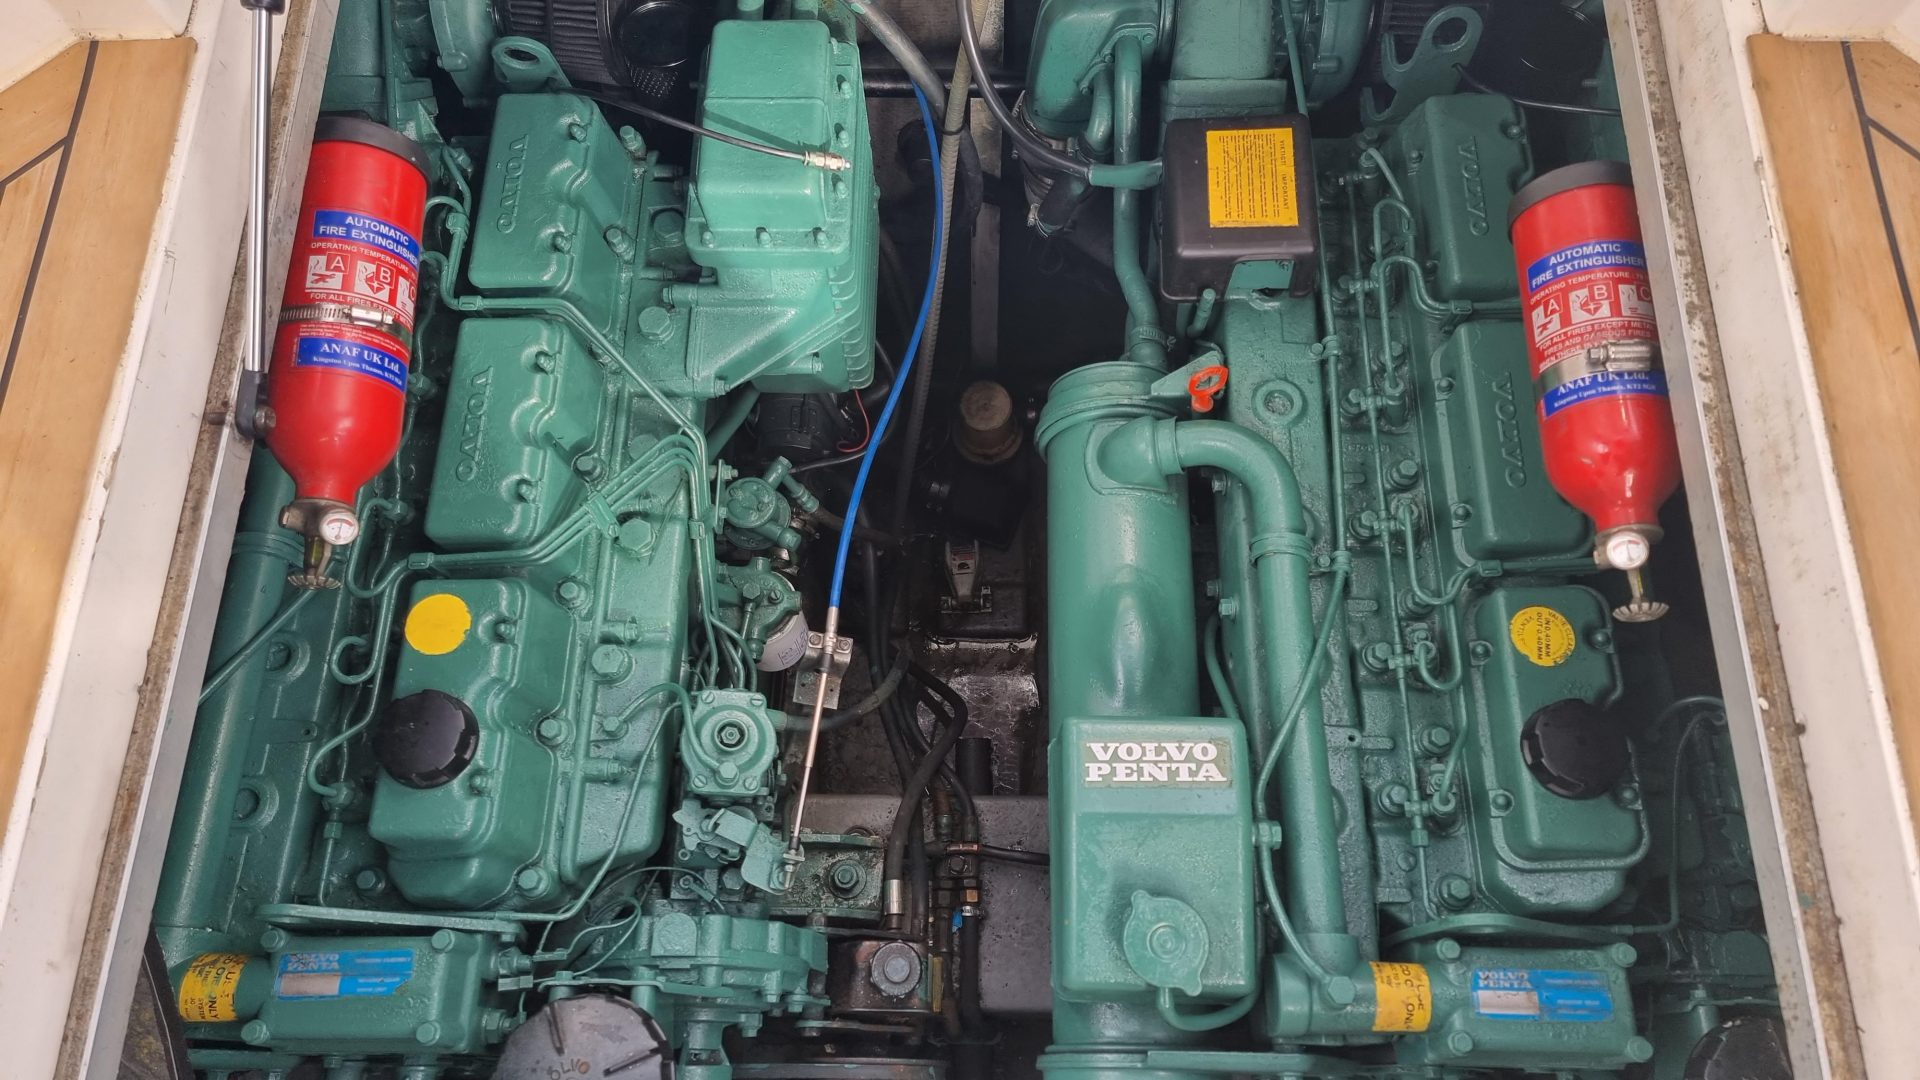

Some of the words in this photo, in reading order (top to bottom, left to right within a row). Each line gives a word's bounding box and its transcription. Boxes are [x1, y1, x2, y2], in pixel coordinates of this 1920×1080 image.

[497, 134, 529, 234] VOLVO
[1281, 173, 1289, 210] IMPORTANT
[1458, 135, 1490, 236] VOLVO
[345, 215, 409, 245] AUTOMATIC
[311, 242, 357, 252] OPERATING
[359, 247, 409, 272] TEMPERATURE
[319, 225, 347, 237] FIRE
[351, 229, 418, 266] EXTINGUISHER
[1549, 243, 1622, 266] AUTOMATIC
[330, 256, 345, 271] A
[379, 267, 391, 283] B
[1532, 270, 1554, 289] FIRE
[1556, 255, 1645, 275] EXTINGUISHER
[310, 292, 326, 300] FOR
[328, 294, 345, 302] ALL
[347, 296, 371, 307] FIRES
[1530, 282, 1566, 305] OPERATING
[1568, 271, 1630, 286] TEMPERATURE
[1593, 284, 1608, 300] B
[1640, 286, 1651, 300] C
[1546, 298, 1560, 316] A
[1552, 333, 1567, 344] ALL
[1567, 326, 1593, 339] FIRES
[1594, 320, 1628, 330] EXCEPT
[1565, 337, 1582, 349] AND
[1629, 329, 1651, 338] FIRES
[320, 342, 361, 357] ANAF
[363, 348, 382, 365] UK
[384, 357, 401, 375] Ltd.
[1557, 375, 1594, 396] ANAF
[1596, 371, 1620, 383] UK
[1623, 371, 1649, 381] Ltd.
[455, 366, 494, 482] VOLVO
[1492, 371, 1527, 488] VOLVO
[1086, 742, 1218, 761] VOLVO
[1084, 762, 1228, 782] PENTA
[1479, 970, 1529, 980] VOLVO
[1479, 980, 1533, 989] PENTA
